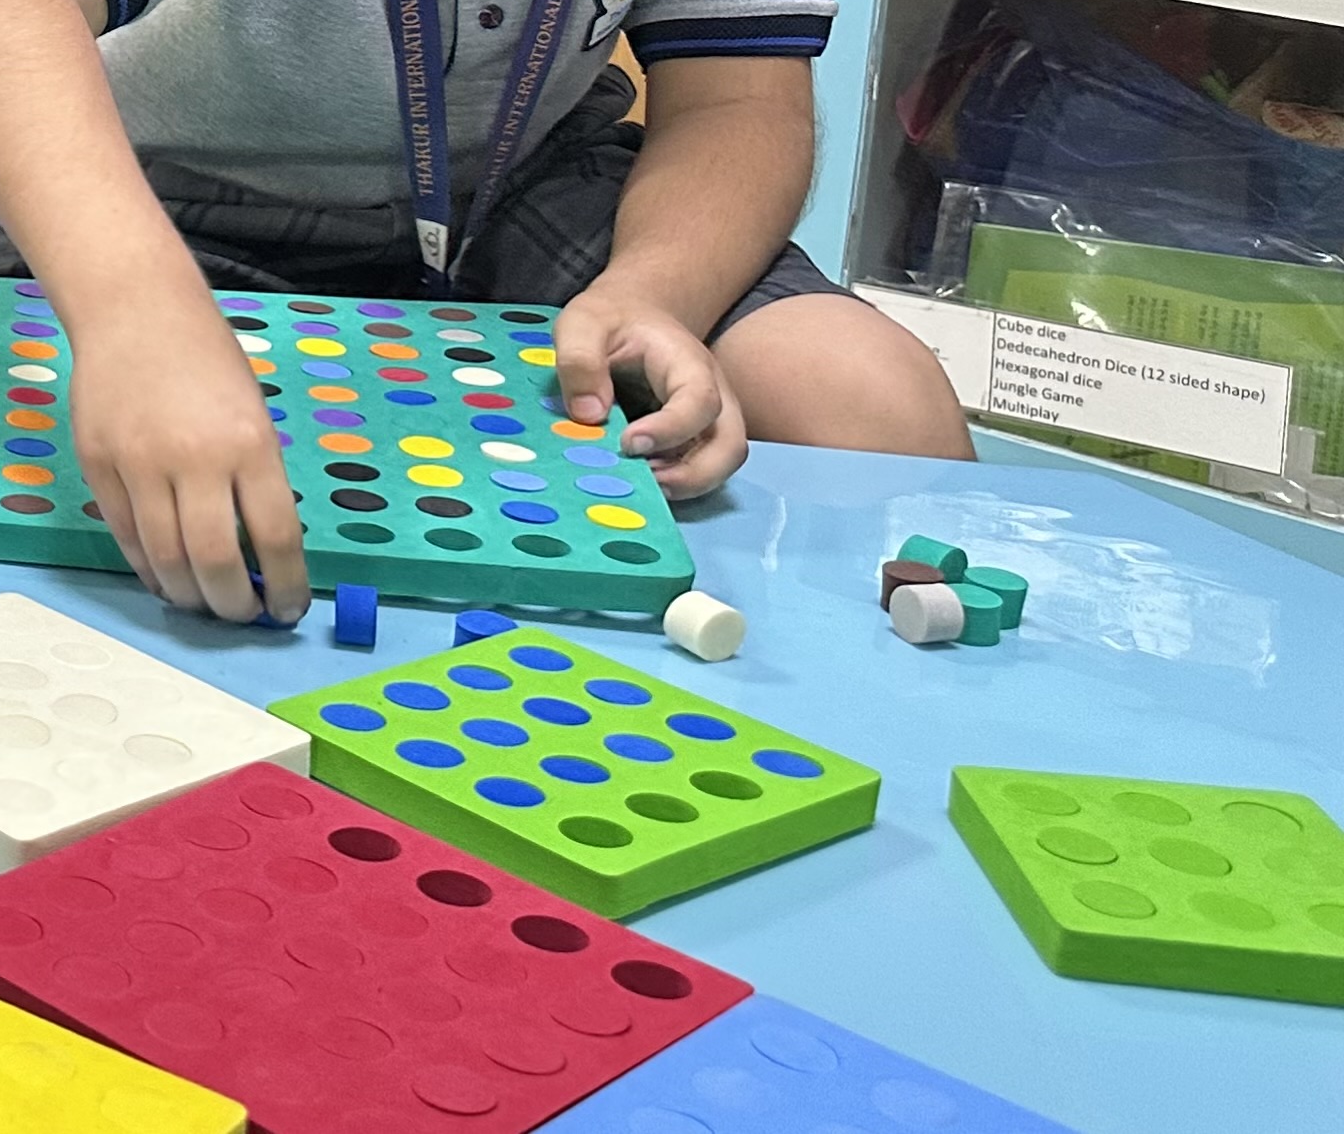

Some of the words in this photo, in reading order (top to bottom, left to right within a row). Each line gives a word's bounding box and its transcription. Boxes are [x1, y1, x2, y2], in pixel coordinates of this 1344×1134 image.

[412, 123, 435, 197] THAKUR
[997, 317, 1035, 335] Cube
[1037, 323, 1067, 342] dice
[995, 357, 1069, 383] Hexagonal
[1072, 372, 1103, 390] dice
[996, 337, 1101, 369] Dedecahedron
[1105, 358, 1137, 376] Dice
[1141, 364, 1166, 382] (12
[1169, 372, 1210, 391] sided
[1214, 381, 1267, 405] shape)
[993, 377, 1039, 399] Jungle
[1041, 387, 1085, 408] Game
[992, 397, 1060, 423] Multiplay
